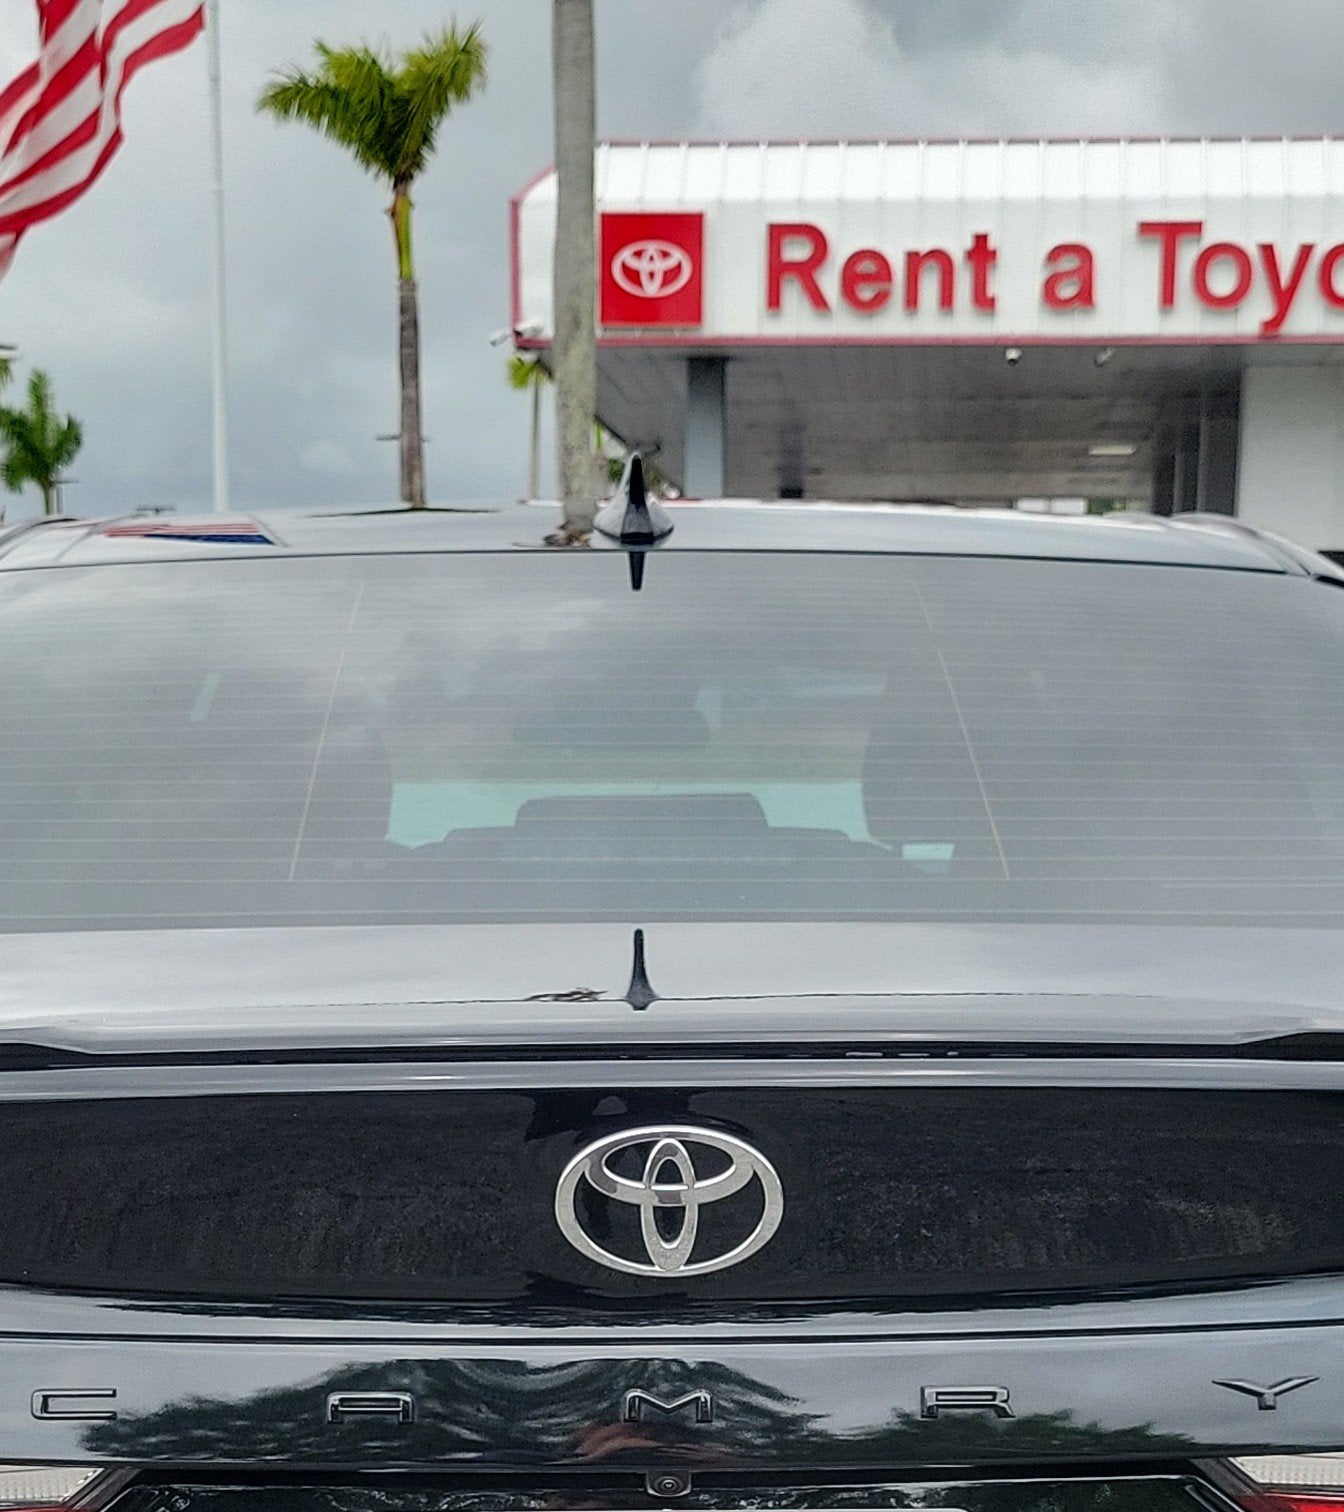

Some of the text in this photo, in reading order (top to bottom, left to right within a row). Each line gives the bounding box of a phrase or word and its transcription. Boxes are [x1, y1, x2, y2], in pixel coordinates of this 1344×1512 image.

[765, 222, 998, 315] Rent
[1042, 242, 1096, 310] a
[30, 1376, 1321, 1424] CAMRY
